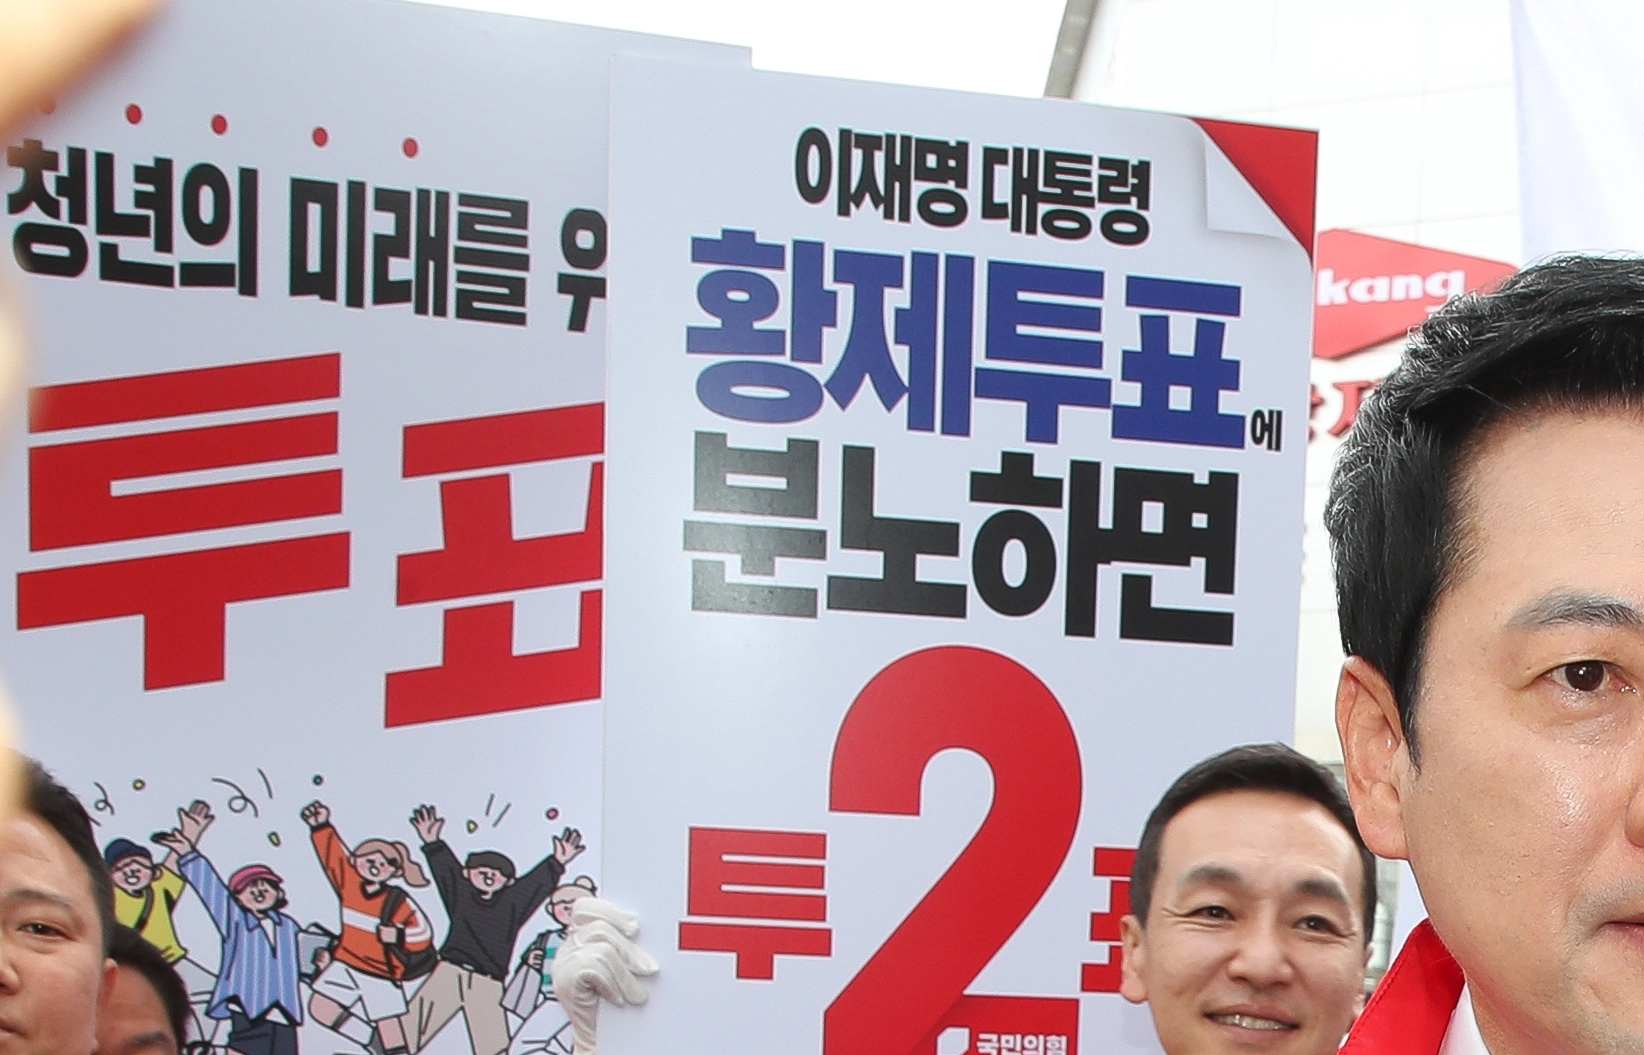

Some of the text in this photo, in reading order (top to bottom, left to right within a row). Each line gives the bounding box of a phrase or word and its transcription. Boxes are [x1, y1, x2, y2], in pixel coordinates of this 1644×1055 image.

[6, 139, 259, 297] 청년의
[289, 176, 530, 327] 미래를
[794, 126, 1151, 246] 이재명 대통령
[683, 430, 1241, 647] 분노하면
